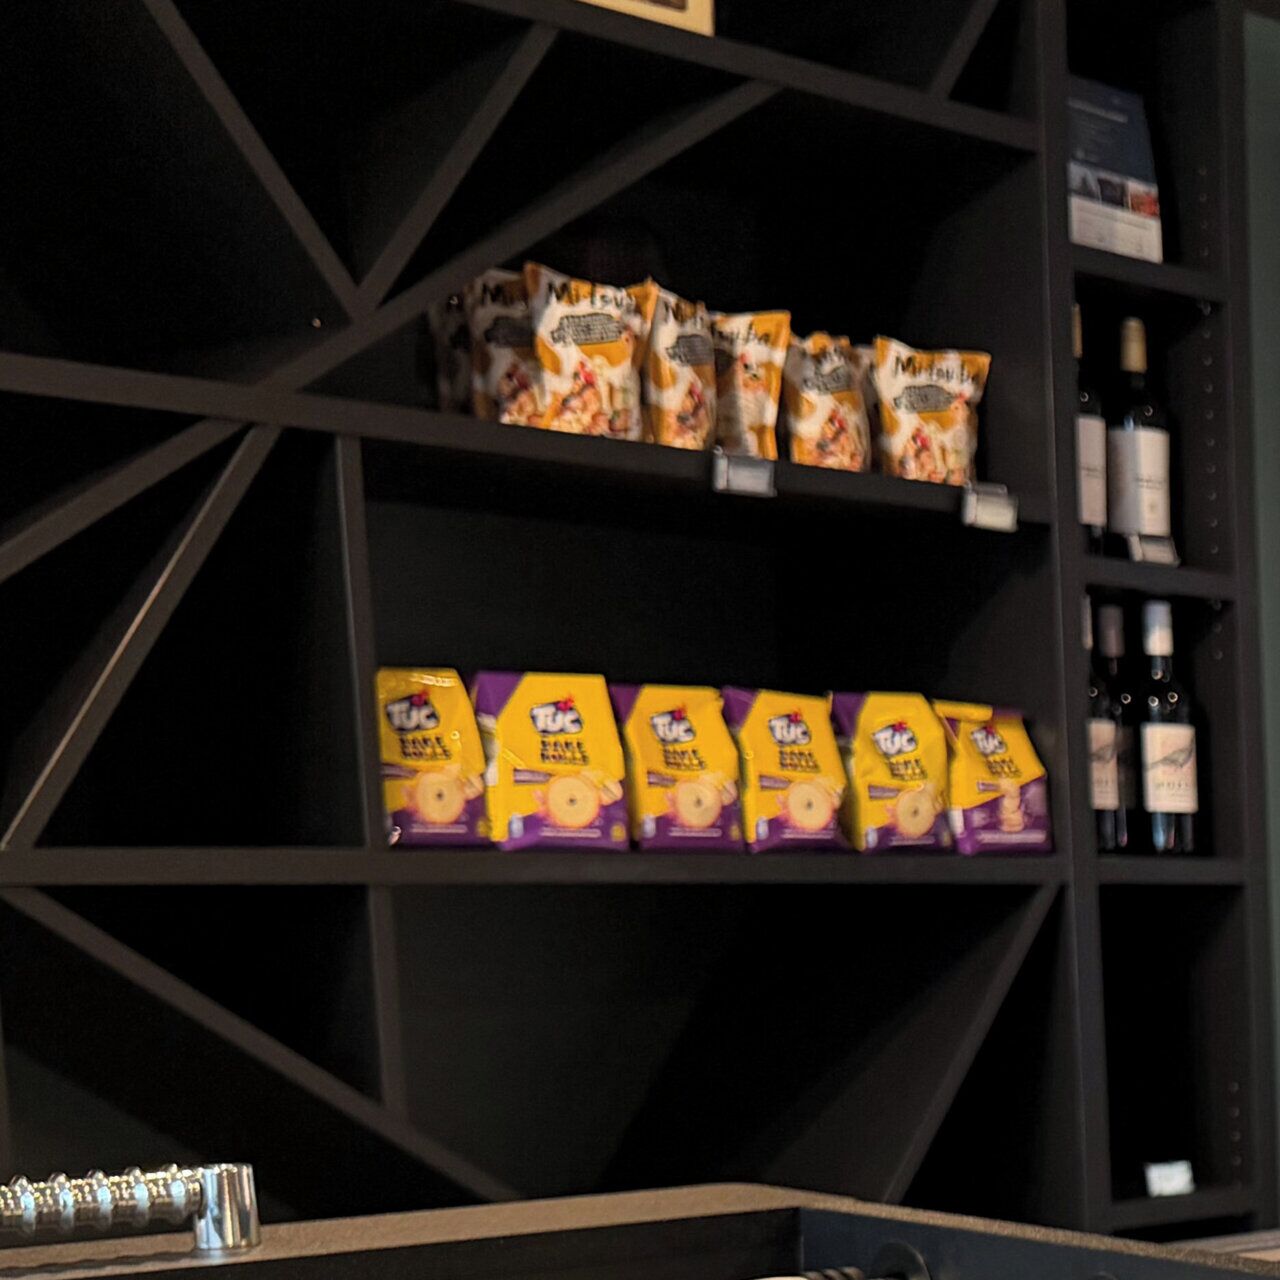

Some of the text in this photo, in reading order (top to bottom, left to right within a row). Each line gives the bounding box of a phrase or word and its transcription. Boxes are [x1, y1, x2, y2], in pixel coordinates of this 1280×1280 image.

[386, 699, 438, 731] TUC
[531, 703, 582, 733] TUC
[651, 713, 695, 742] TUC
[769, 714, 811, 744] TUC
[874, 727, 917, 754] TUC
